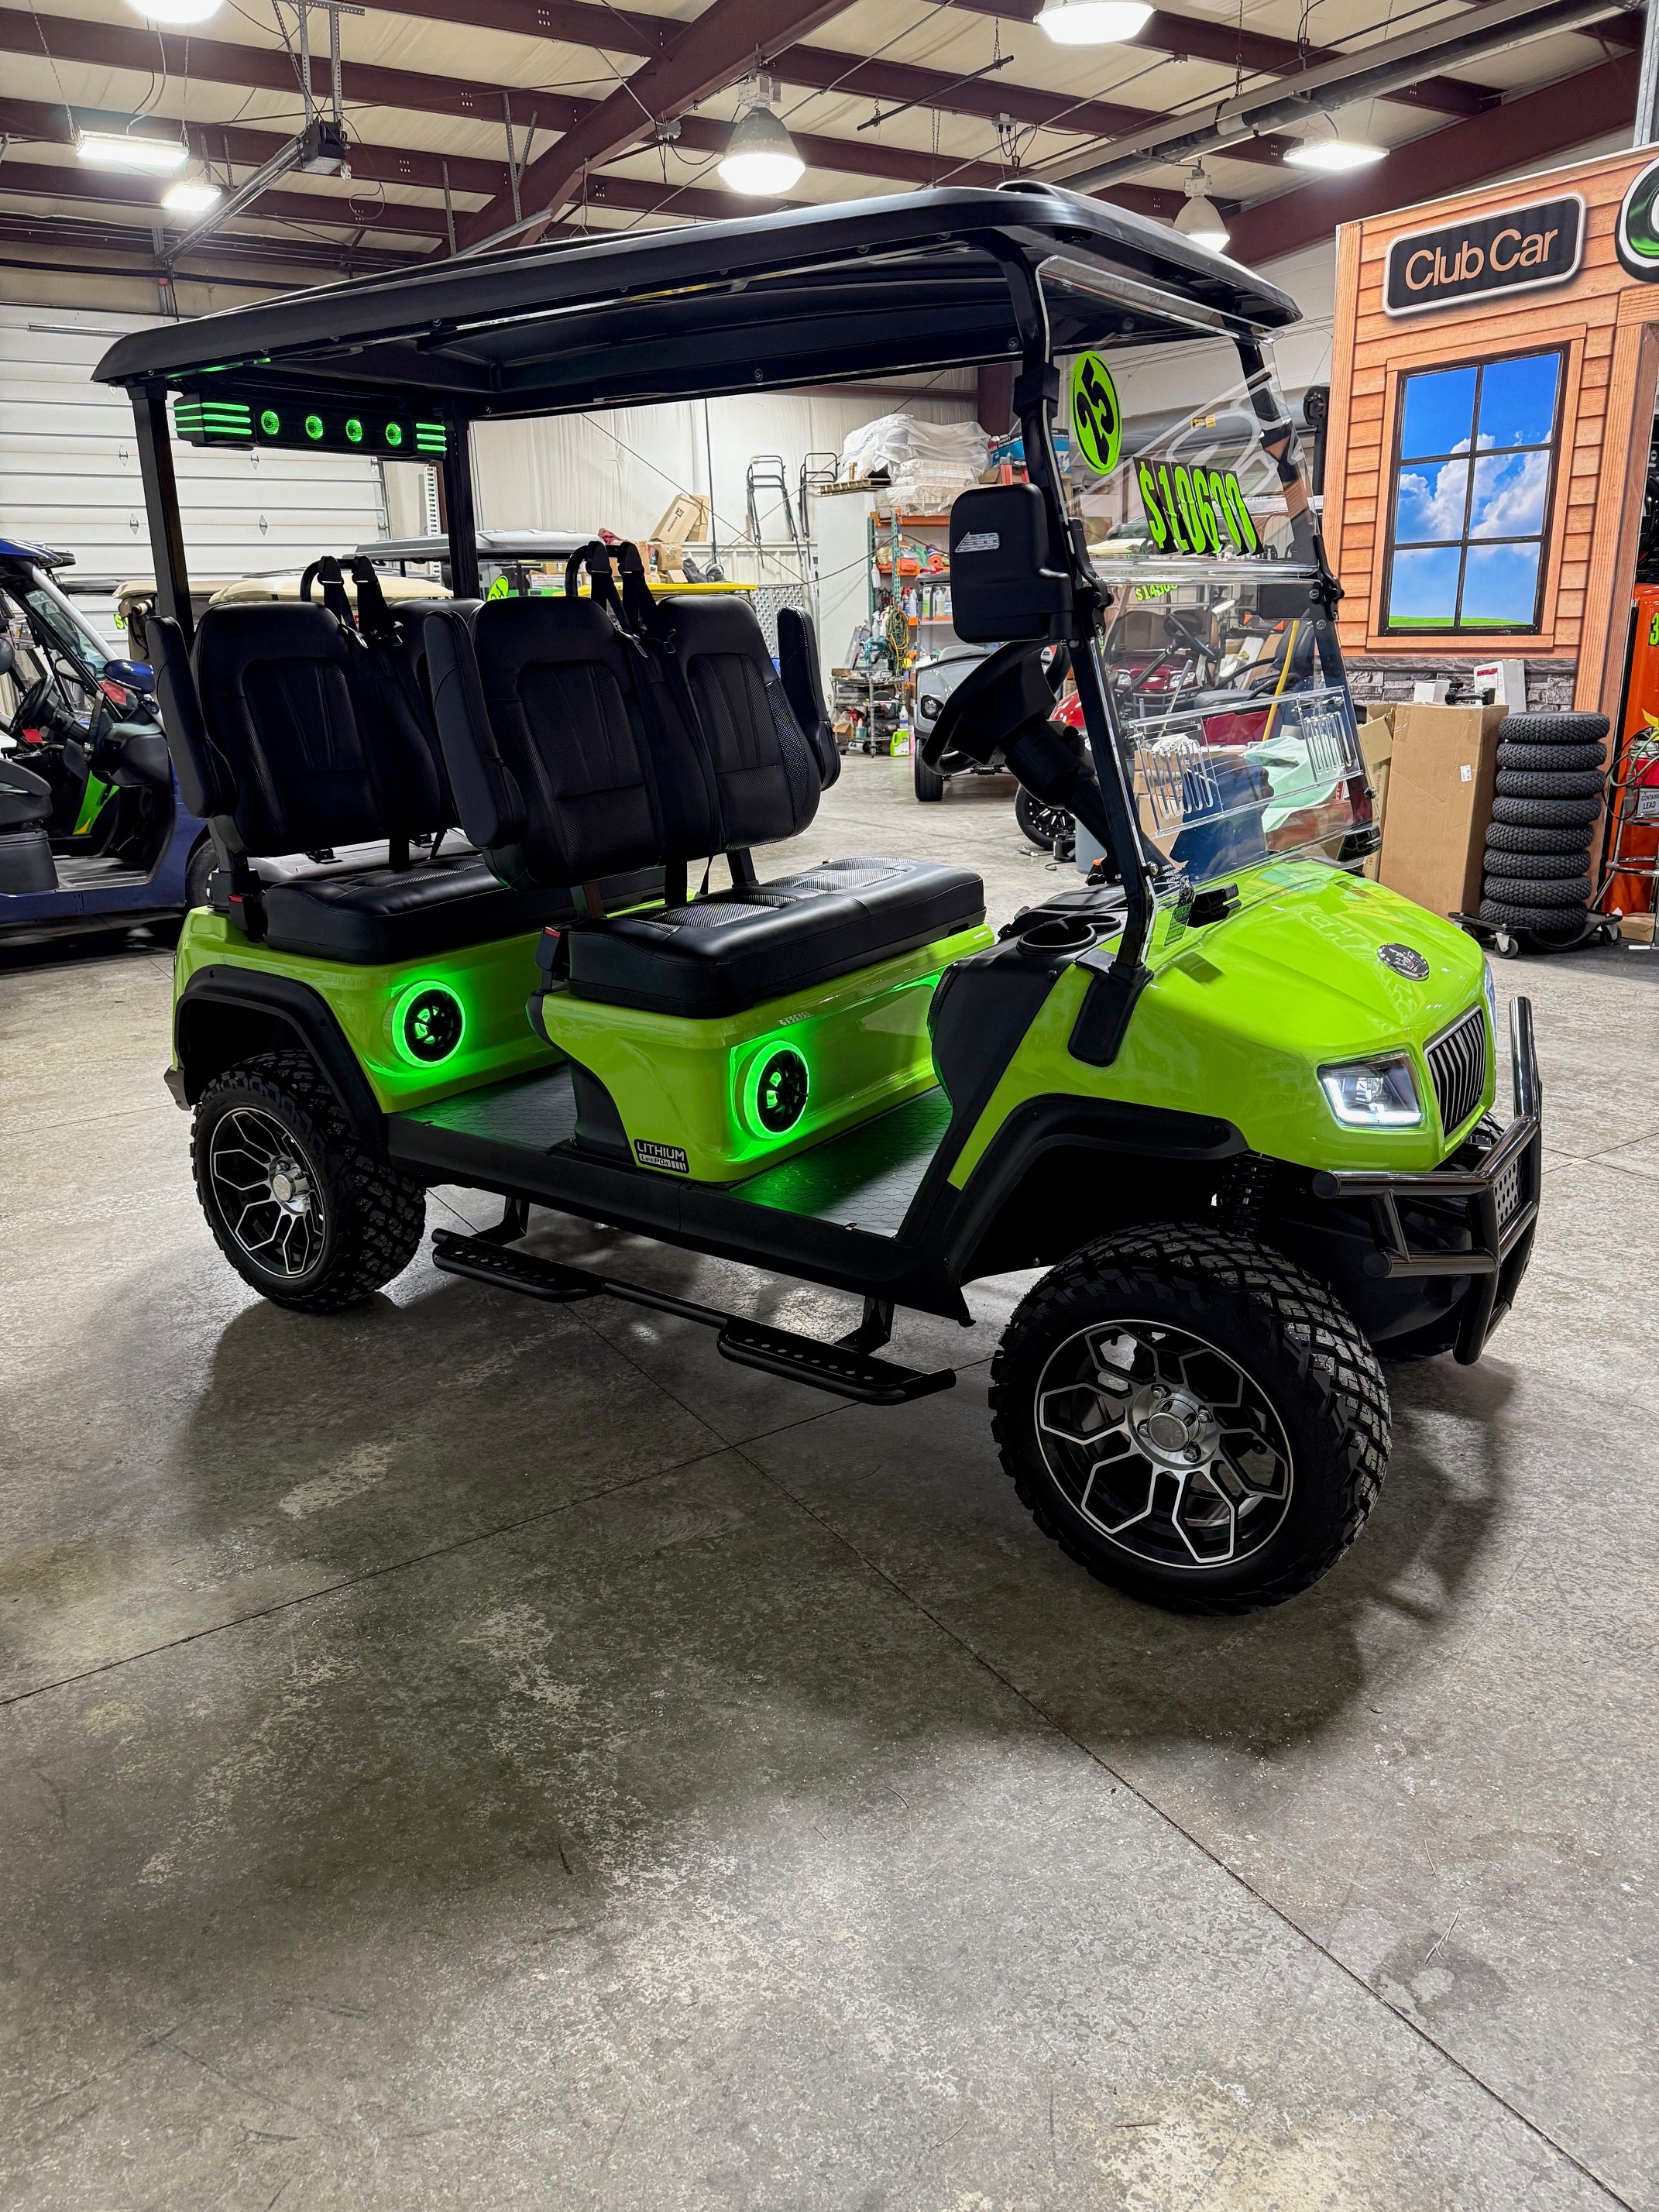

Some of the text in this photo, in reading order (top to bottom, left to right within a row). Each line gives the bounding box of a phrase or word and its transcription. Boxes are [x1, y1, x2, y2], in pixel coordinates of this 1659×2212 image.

[1405, 228, 1559, 290] Club Car
[1077, 357, 1115, 465] 25
[1643, 801, 1657, 809] LEAD
[637, 1141, 685, 1161] LITHIUM
